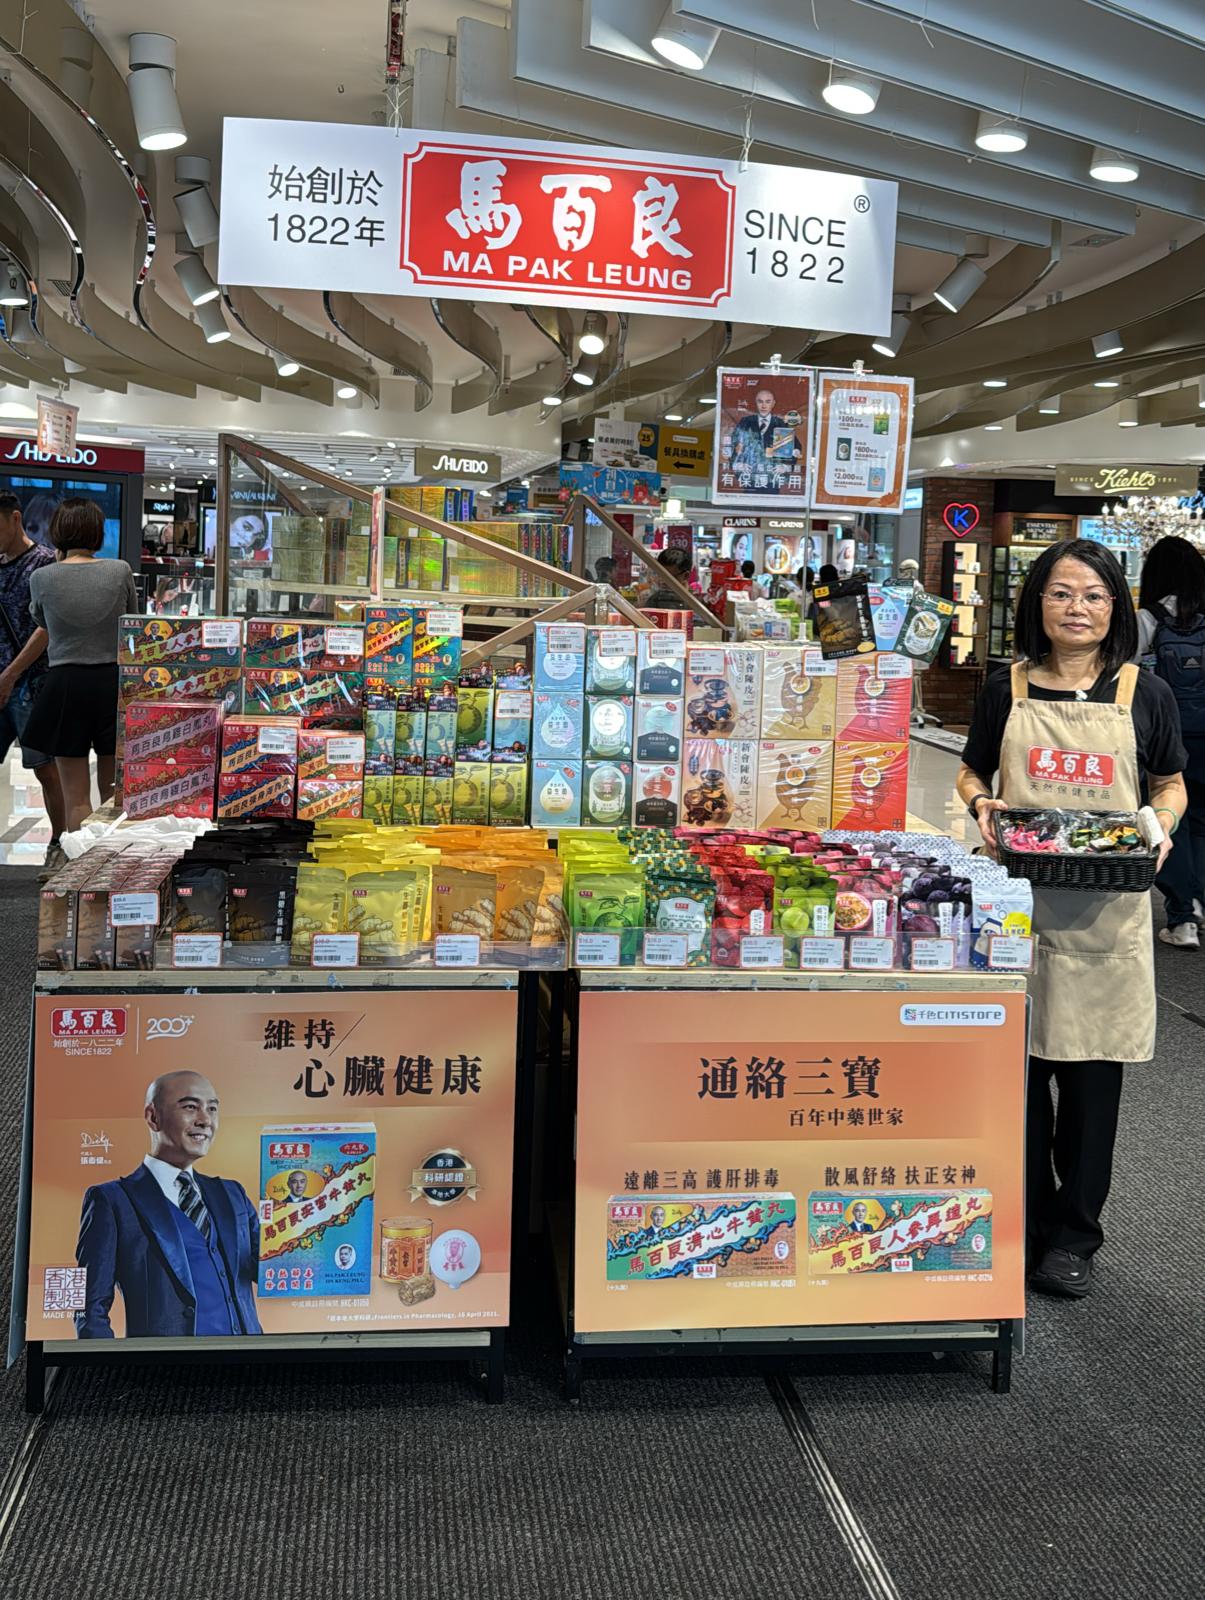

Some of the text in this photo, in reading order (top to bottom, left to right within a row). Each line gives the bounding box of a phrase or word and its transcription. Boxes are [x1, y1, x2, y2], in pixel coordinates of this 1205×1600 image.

[267, 164, 384, 208] 始創於
[445, 159, 694, 260] 馬百良
[266, 212, 386, 248] 1822年
[744, 208, 846, 248] SINCE
[443, 250, 693, 292] MA PAK LEUNG
[747, 247, 845, 285] 1822
[433, 455, 488, 475] SHISEIDO
[722, 473, 801, 489] 有保護作用
[1095, 469, 1157, 489] Kiehl's
[724, 518, 757, 526] CLARINS
[769, 520, 804, 529] CLARINS
[953, 510, 969, 529] K
[1036, 749, 1104, 776] 馬百良
[1035, 770, 1103, 785] MA PAK LEUNG
[1029, 781, 1112, 800] 天然保健食品
[59, 1010, 117, 1030] 馬百良
[53, 1038, 124, 1048] 始創於一八二二年
[263, 1019, 336, 1050] 維持
[293, 1054, 482, 1098] 心臟健康
[698, 1056, 881, 1100] 通絡三寶
[788, 1107, 904, 1128] 百年中藥世家
[437, 1158, 453, 1167] 香港
[424, 1172, 464, 1183] 科研認證
[624, 1167, 780, 1191] 遠離三高 護肝排毒
[824, 1164, 977, 1187] 散風舒絡 扶正安神
[45, 1268, 86, 1289] 香港
[44, 1289, 86, 1310] 製造
[43, 1311, 65, 1319] MADE
[76, 1310, 87, 1318] HK
